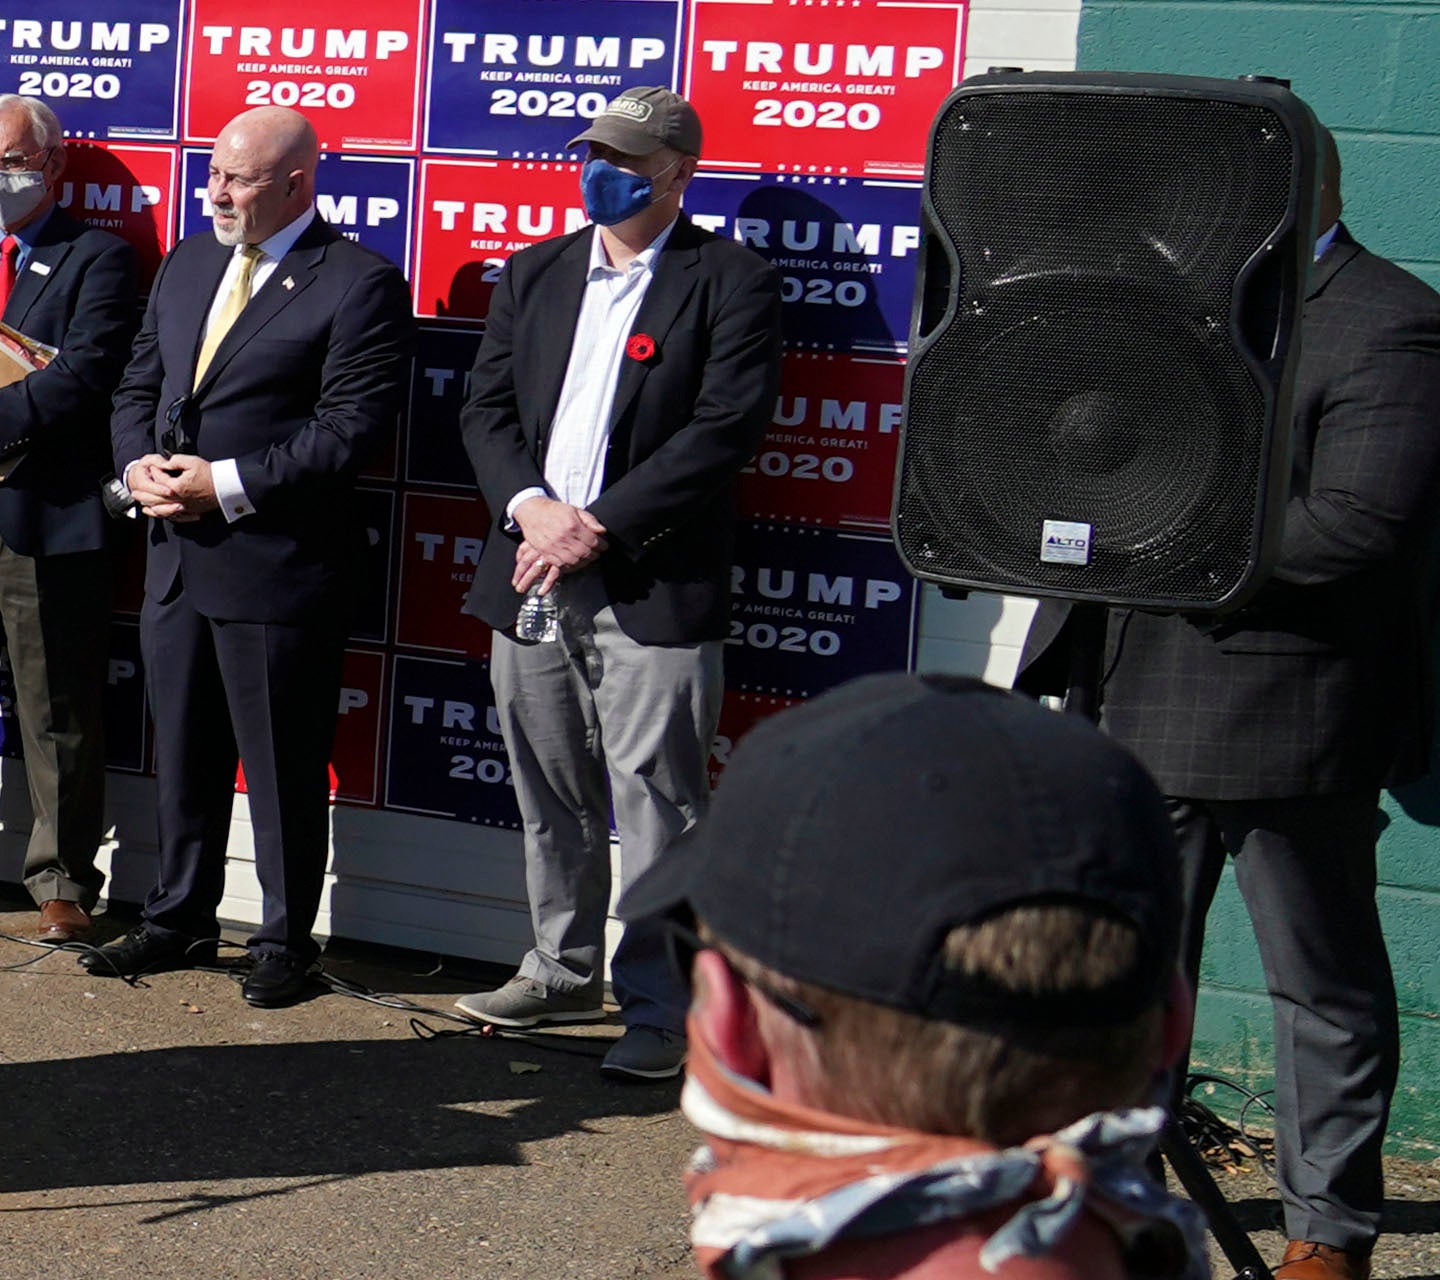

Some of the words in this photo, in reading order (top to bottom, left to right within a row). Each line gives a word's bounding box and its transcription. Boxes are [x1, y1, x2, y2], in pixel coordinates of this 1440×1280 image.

[203, 26, 408, 59] TRUMP
[444, 33, 665, 68] TRUMP
[11, 55, 37, 64] KEEP
[40, 56, 88, 65] AMERICA
[92, 58, 131, 67] GREAT!
[237, 63, 266, 72] KEEP
[270, 64, 321, 74] AMERICA
[326, 66, 367, 75] GREAT!
[703, 41, 943, 77] TRUMP
[19, 72, 120, 99] 2020
[481, 71, 512, 81] KEEP
[515, 72, 571, 83] AMERICA
[575, 74, 621, 84] GREAT!
[743, 81, 777, 90] KEEP
[781, 82, 841, 93] AMERICA
[846, 84, 895, 94] GREAT!
[246, 81, 354, 110] 2020
[490, 89, 607, 118] 2020
[753, 100, 880, 130] 2020
[58, 180, 162, 214] UMP
[194, 187, 400, 226] TMP
[432, 200, 592, 237] TRU
[470, 239, 502, 251] KEEP
[833, 261, 882, 274] GREAT!
[780, 276, 867, 308] 020
[772, 395, 903, 434] UMP
[765, 432, 816, 447] MERICA
[820, 435, 870, 450] GREAT!
[1046, 535, 1086, 548] ALTO
[746, 604, 803, 620] AMERICA
[807, 610, 856, 625] GREAT!
[440, 735, 471, 747] KEEP
